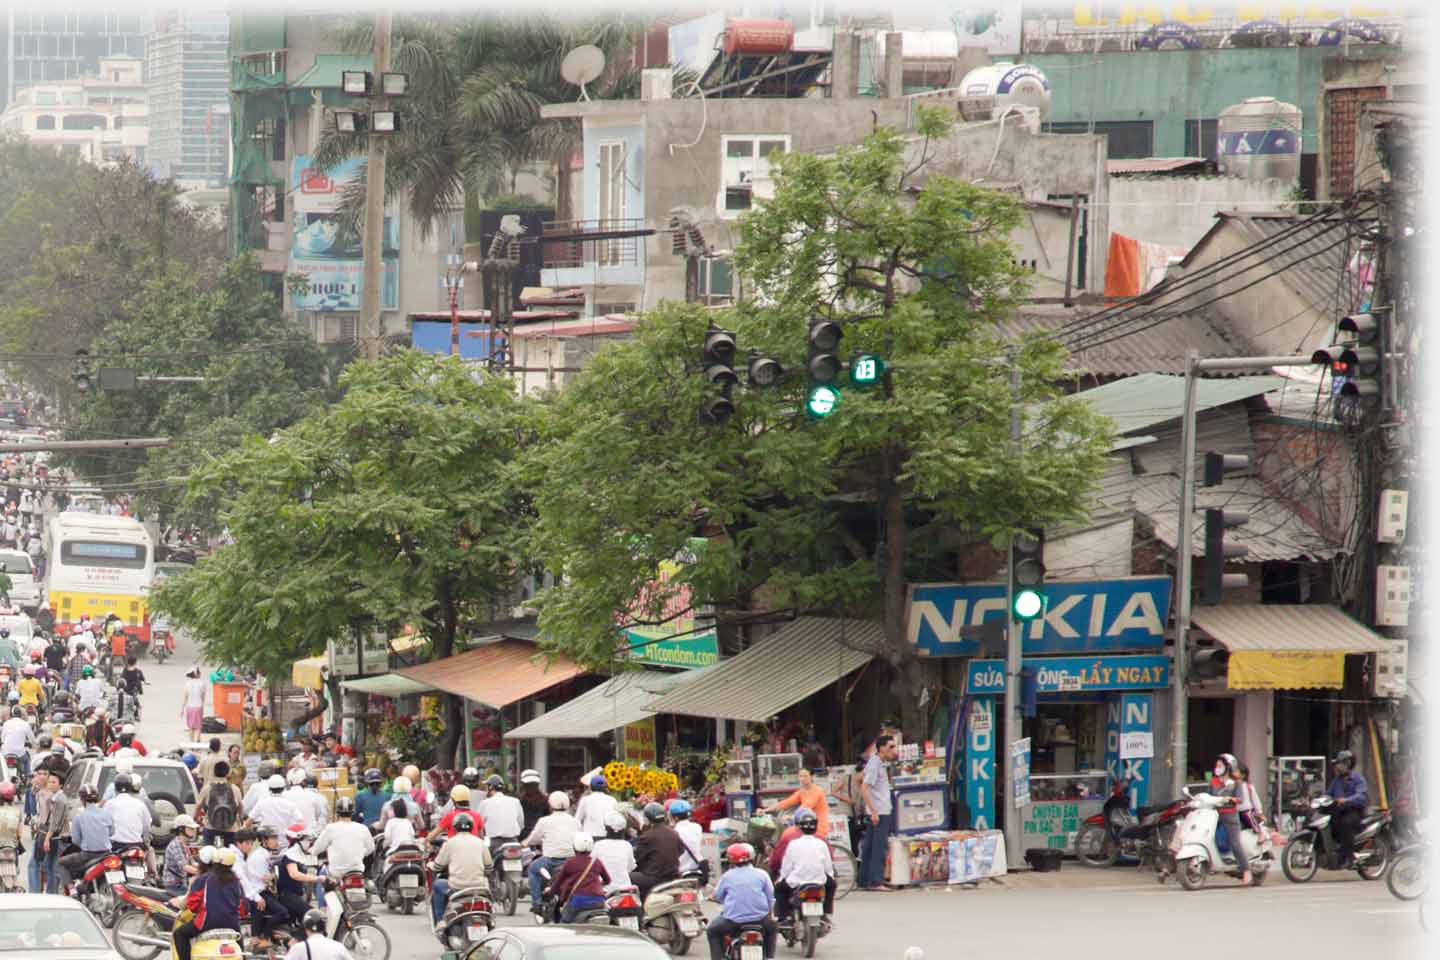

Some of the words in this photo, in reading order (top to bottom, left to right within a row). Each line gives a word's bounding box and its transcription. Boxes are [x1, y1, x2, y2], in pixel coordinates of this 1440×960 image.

[973, 666, 1004, 687] SỬA
[1080, 662, 1112, 685] LẤY
[1116, 666, 1164, 684] NGAY
